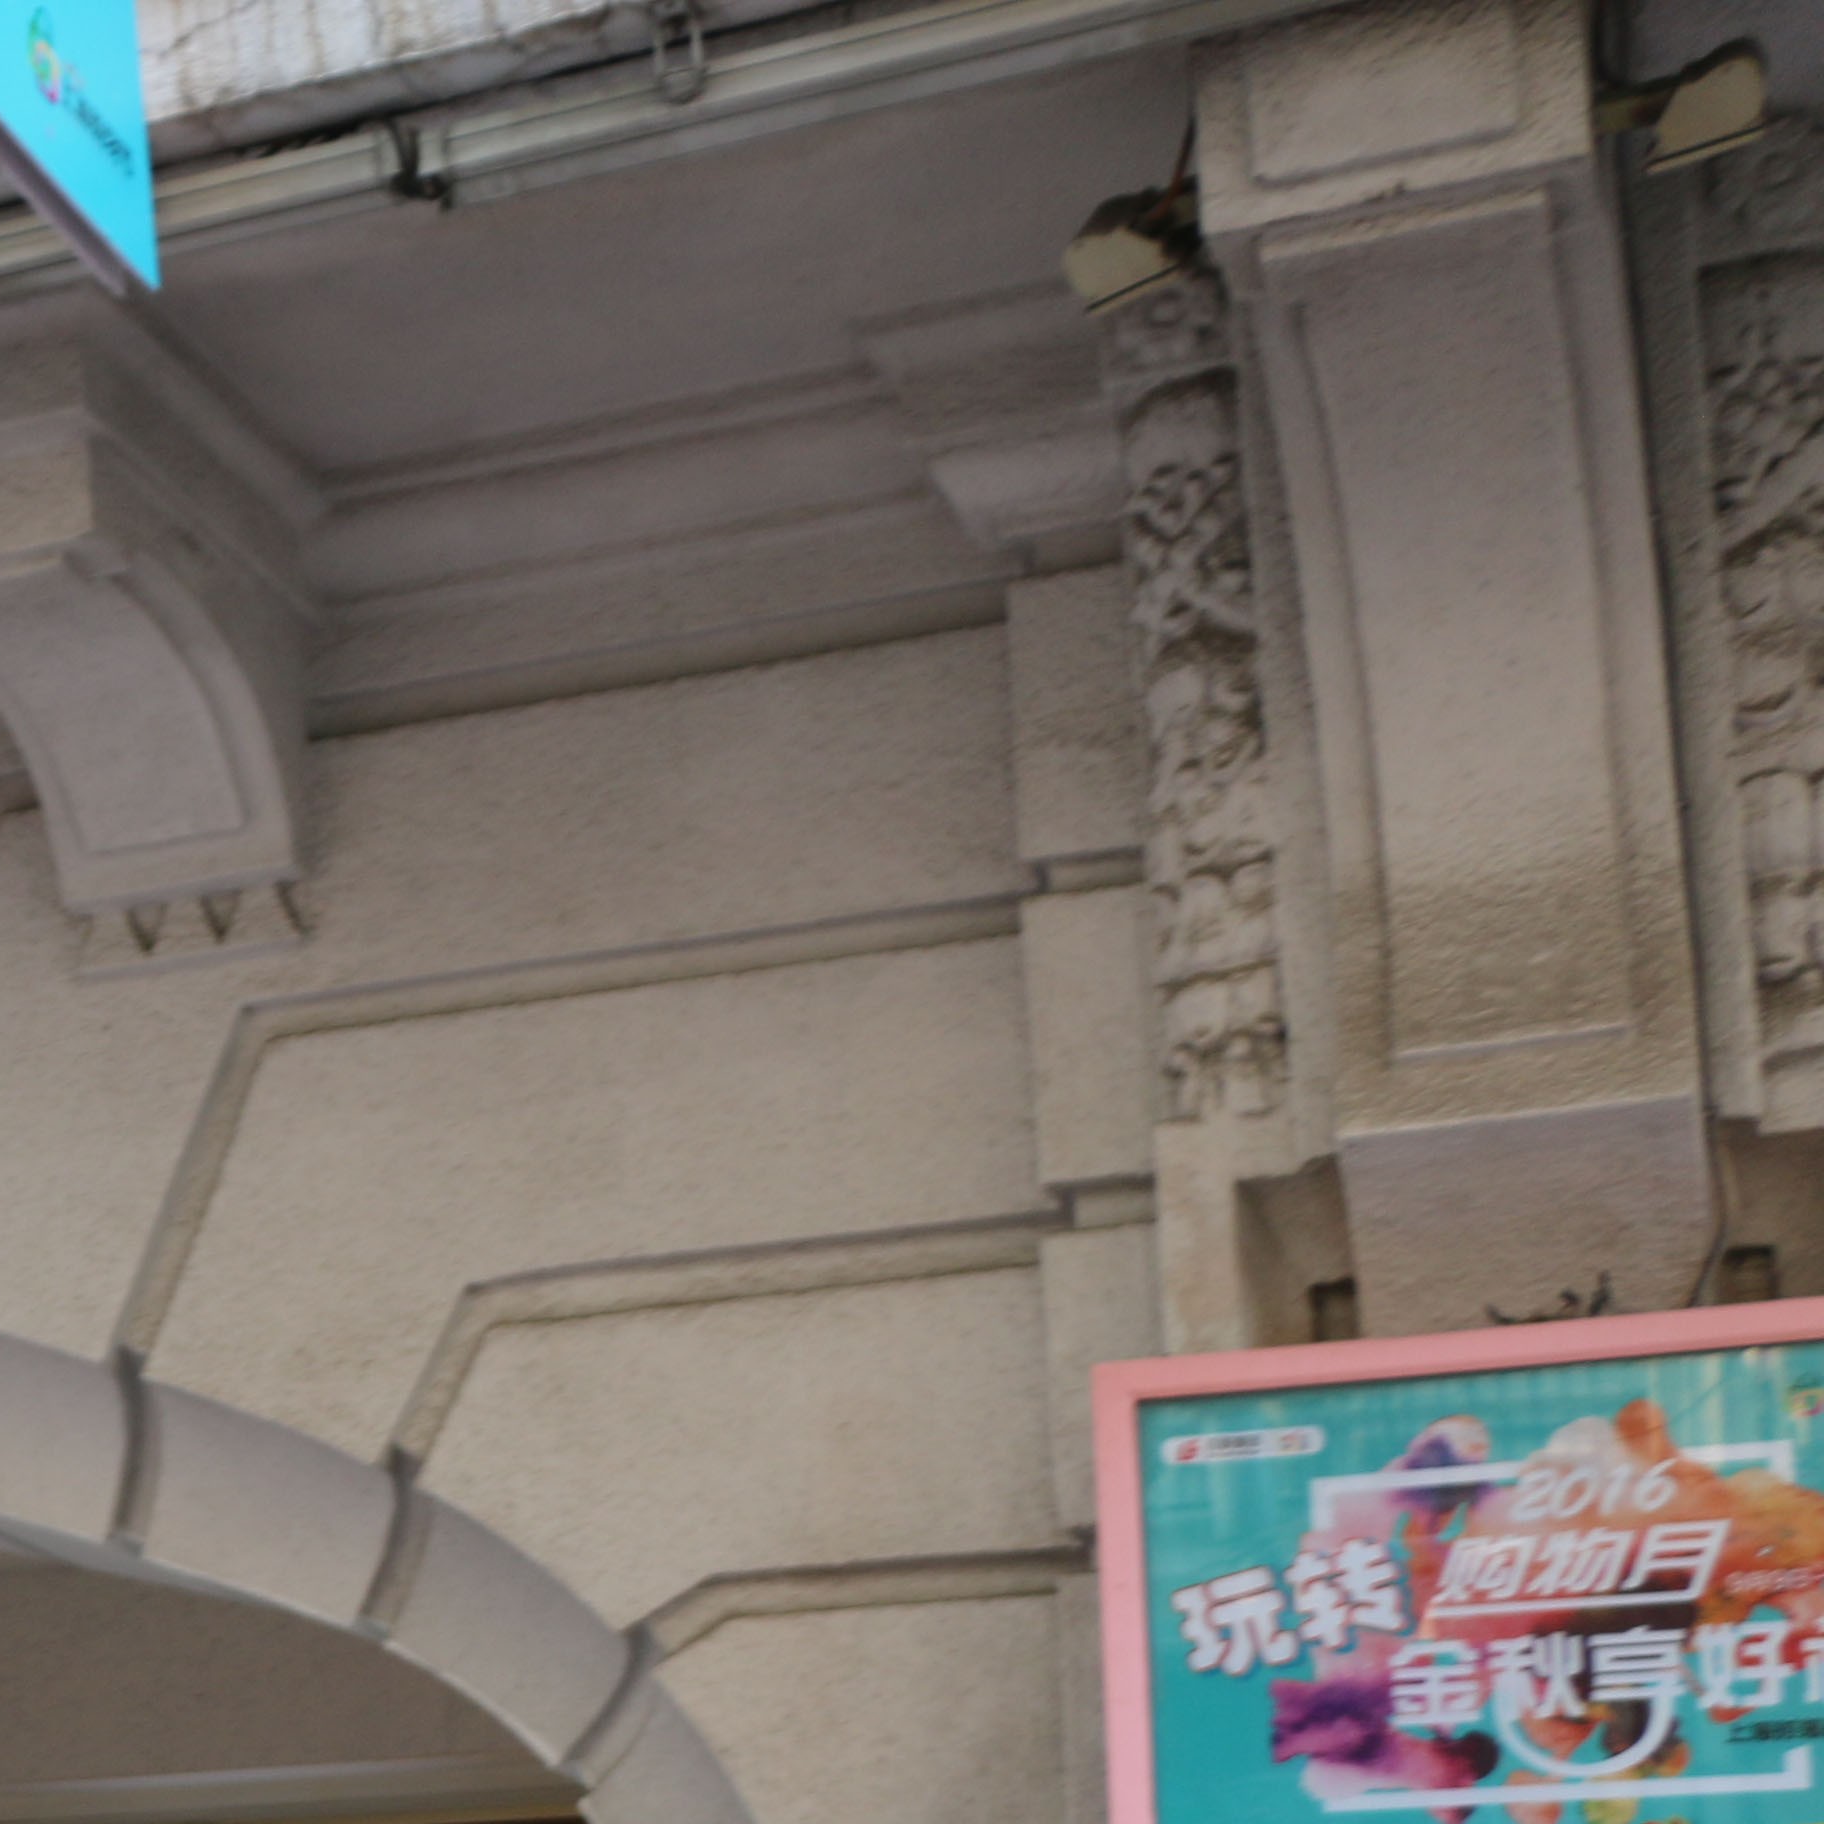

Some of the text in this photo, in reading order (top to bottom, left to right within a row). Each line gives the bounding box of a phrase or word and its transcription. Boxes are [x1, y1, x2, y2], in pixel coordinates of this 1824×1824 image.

[1509, 1460, 1679, 1521] 2016
[1436, 1518, 1731, 1604] 购物月
[1171, 1540, 1409, 1676] 玩转
